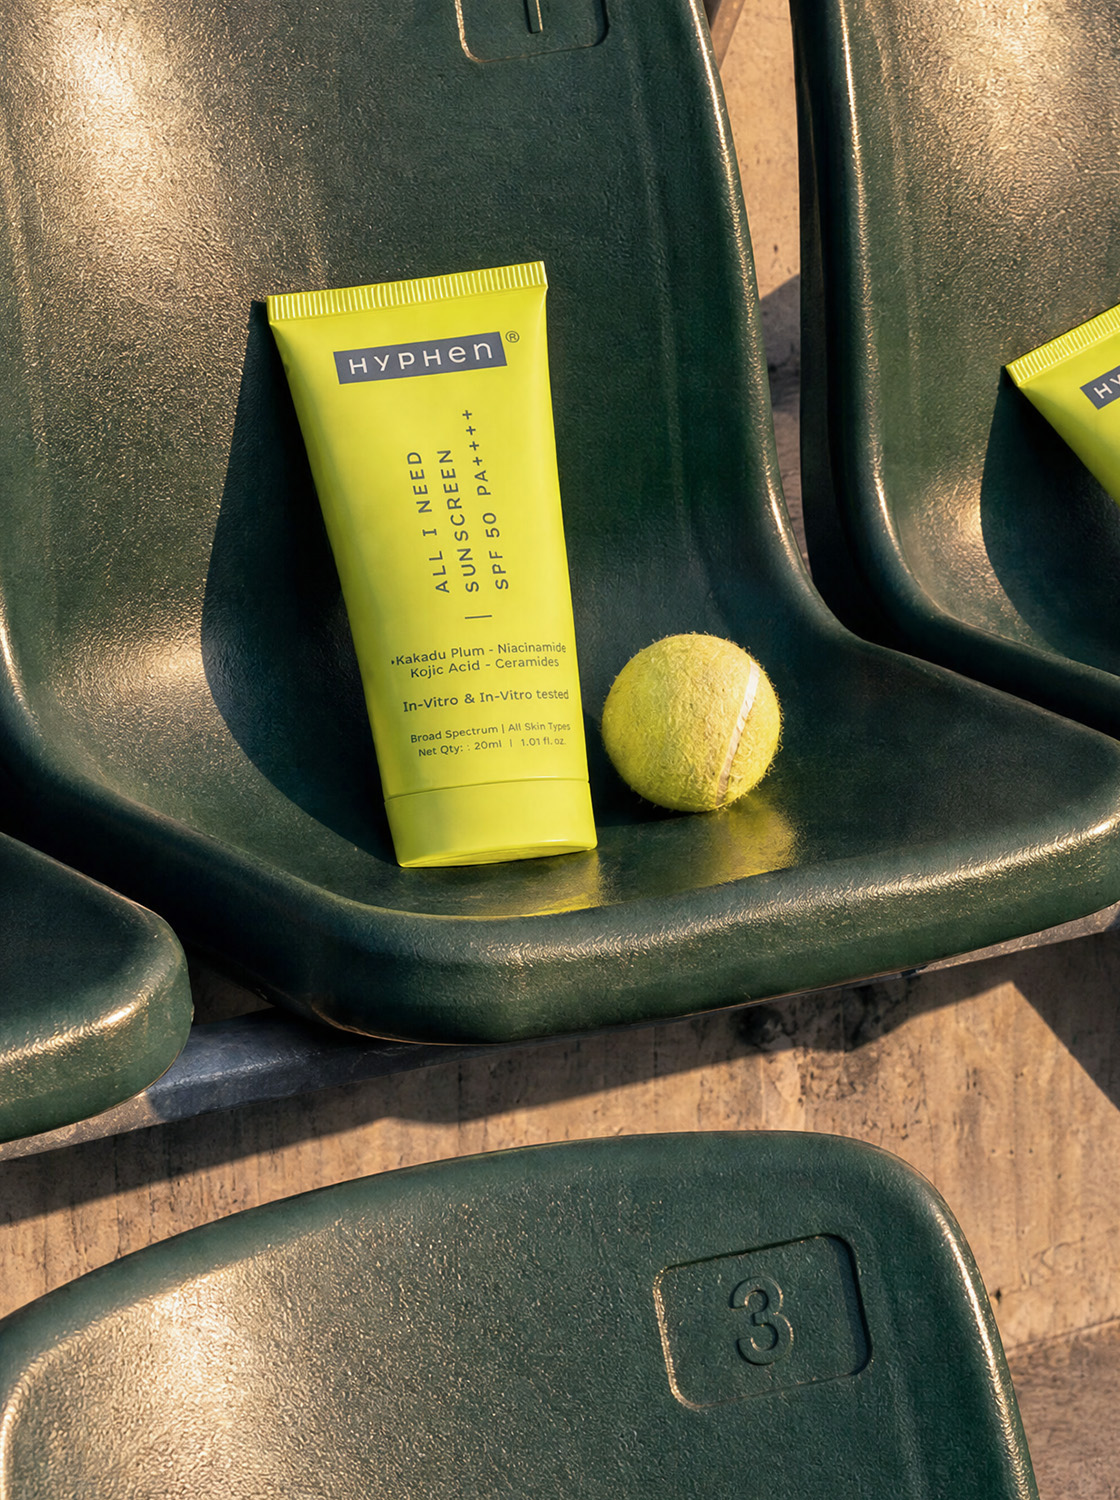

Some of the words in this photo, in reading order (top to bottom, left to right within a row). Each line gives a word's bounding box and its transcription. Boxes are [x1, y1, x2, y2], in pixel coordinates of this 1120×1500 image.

[407, 452, 432, 513] NEED
[422, 528, 437, 536] I
[437, 450, 479, 592] SUNSCREEN
[482, 512, 500, 538] 50
[429, 550, 450, 593] ALL
[489, 550, 509, 590] SPF
[451, 647, 485, 658] Plum
[498, 642, 566, 654] Niacinamide
[411, 665, 444, 679] Kojic
[448, 660, 480, 673] Acid
[495, 656, 559, 669] Ceramides
[403, 697, 458, 712] In-Vitro
[464, 693, 475, 704] &
[480, 690, 532, 703] In-Vitro
[536, 689, 569, 700] tested
[411, 731, 442, 743] Broad
[445, 727, 498, 740] Spectrum
[508, 723, 521, 732] All
[524, 722, 546, 731] Skin
[547, 722, 571, 732] Types
[419, 747, 437, 757] Net
[440, 745, 463, 755] Qty:
[474, 740, 502, 750] 20ml
[521, 738, 540, 746] 1.01
[729, 1276, 796, 1366] 3
